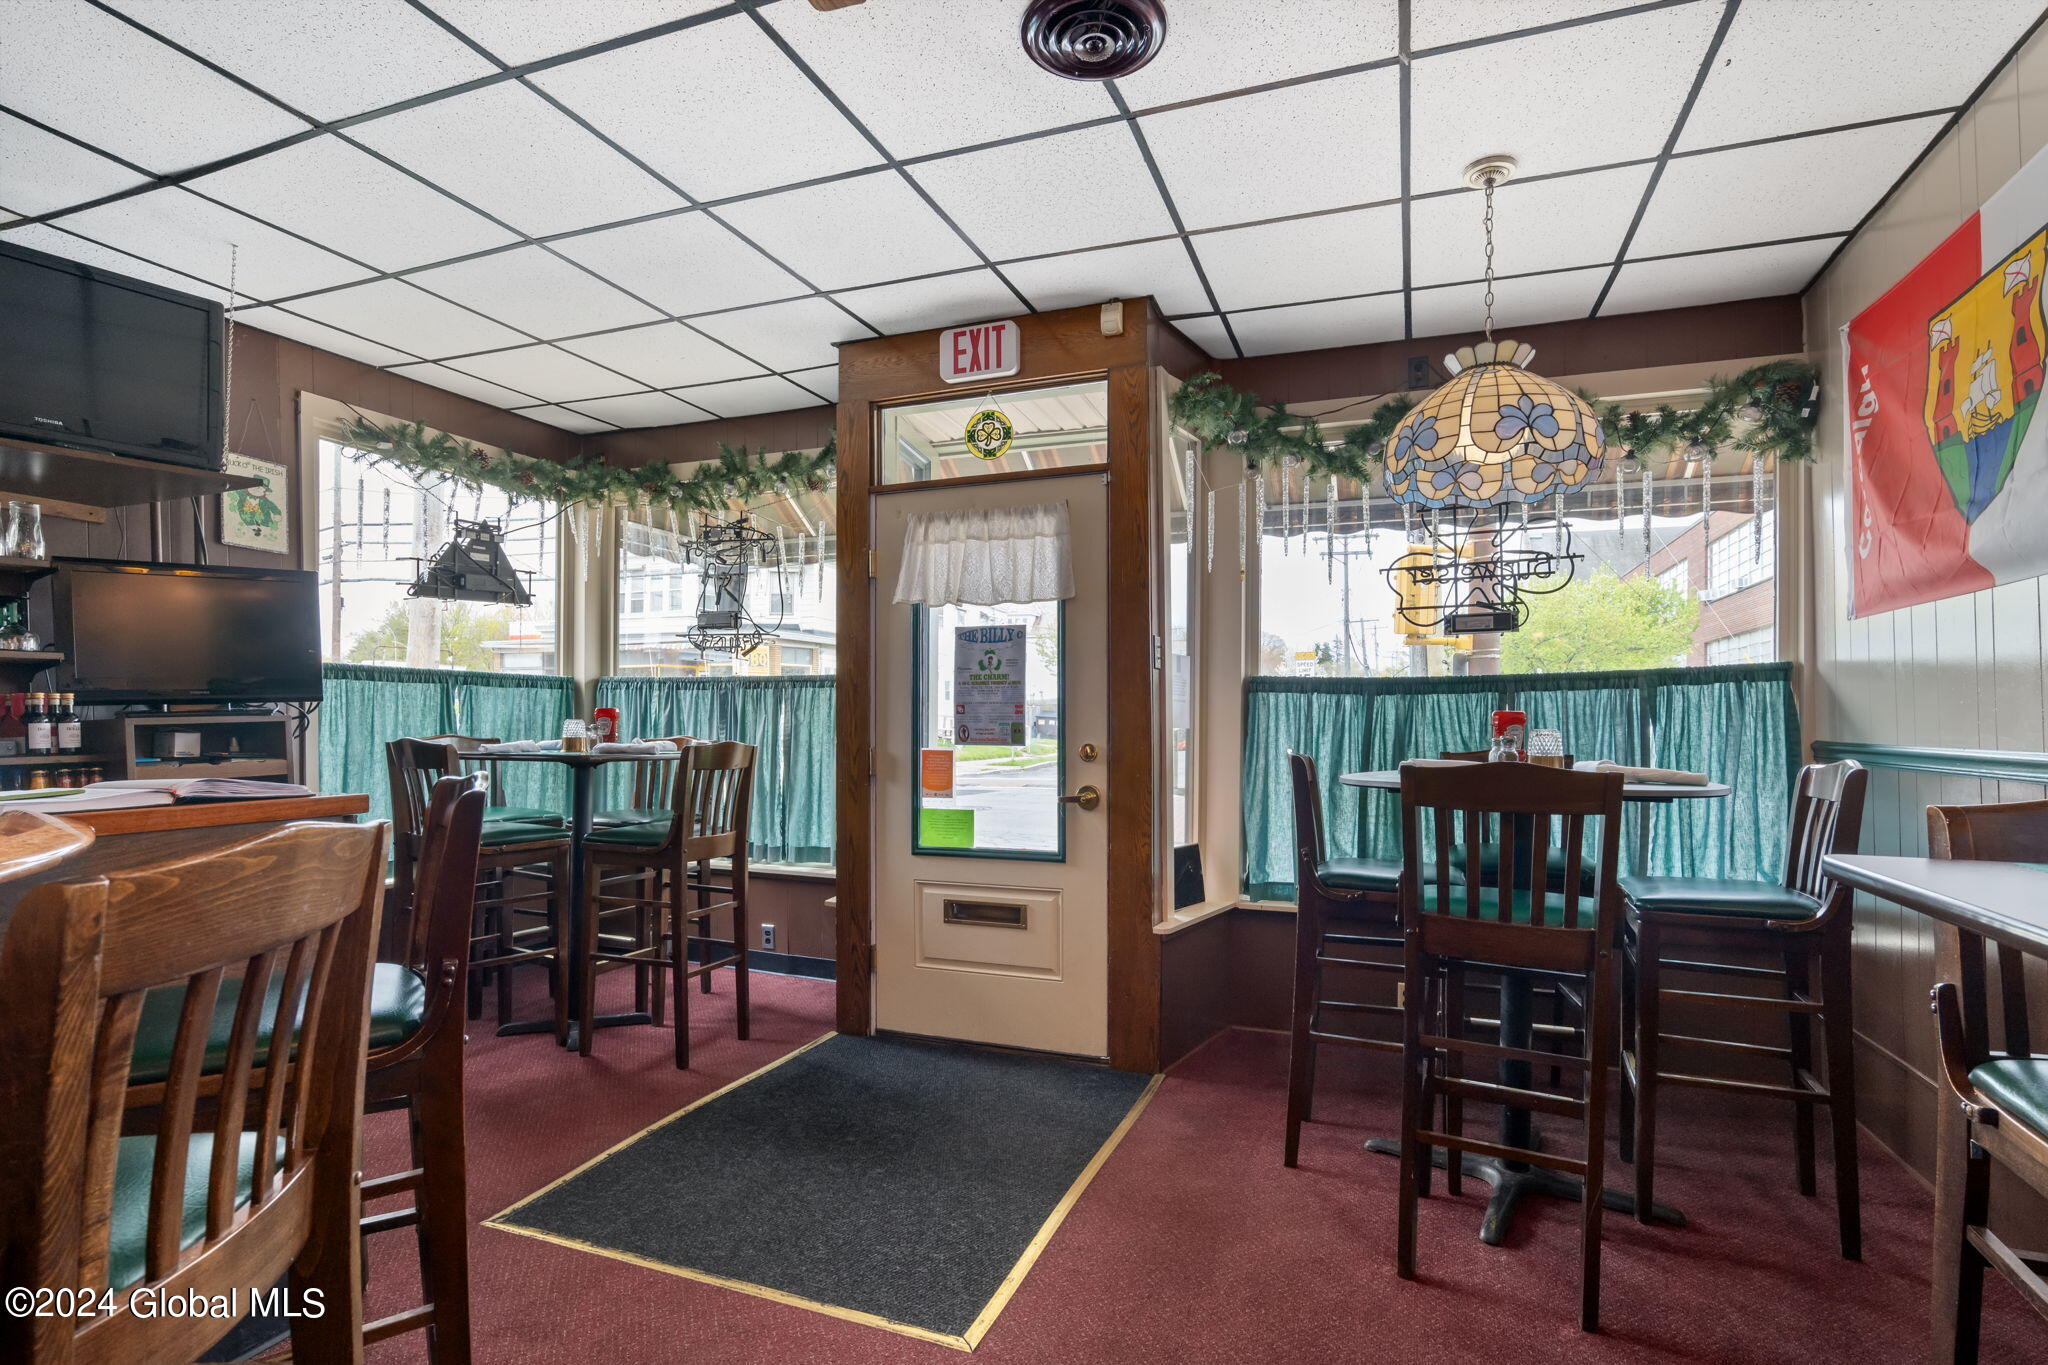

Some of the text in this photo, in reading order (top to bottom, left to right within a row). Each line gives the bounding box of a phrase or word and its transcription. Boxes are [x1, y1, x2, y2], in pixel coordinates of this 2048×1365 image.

[953, 324, 1006, 375] EXIT
[33, 416, 64, 426] TOSHIBA
[252, 464, 264, 473] THE
[264, 466, 283, 477] IRISH
[980, 627, 1015, 644] BILLY
